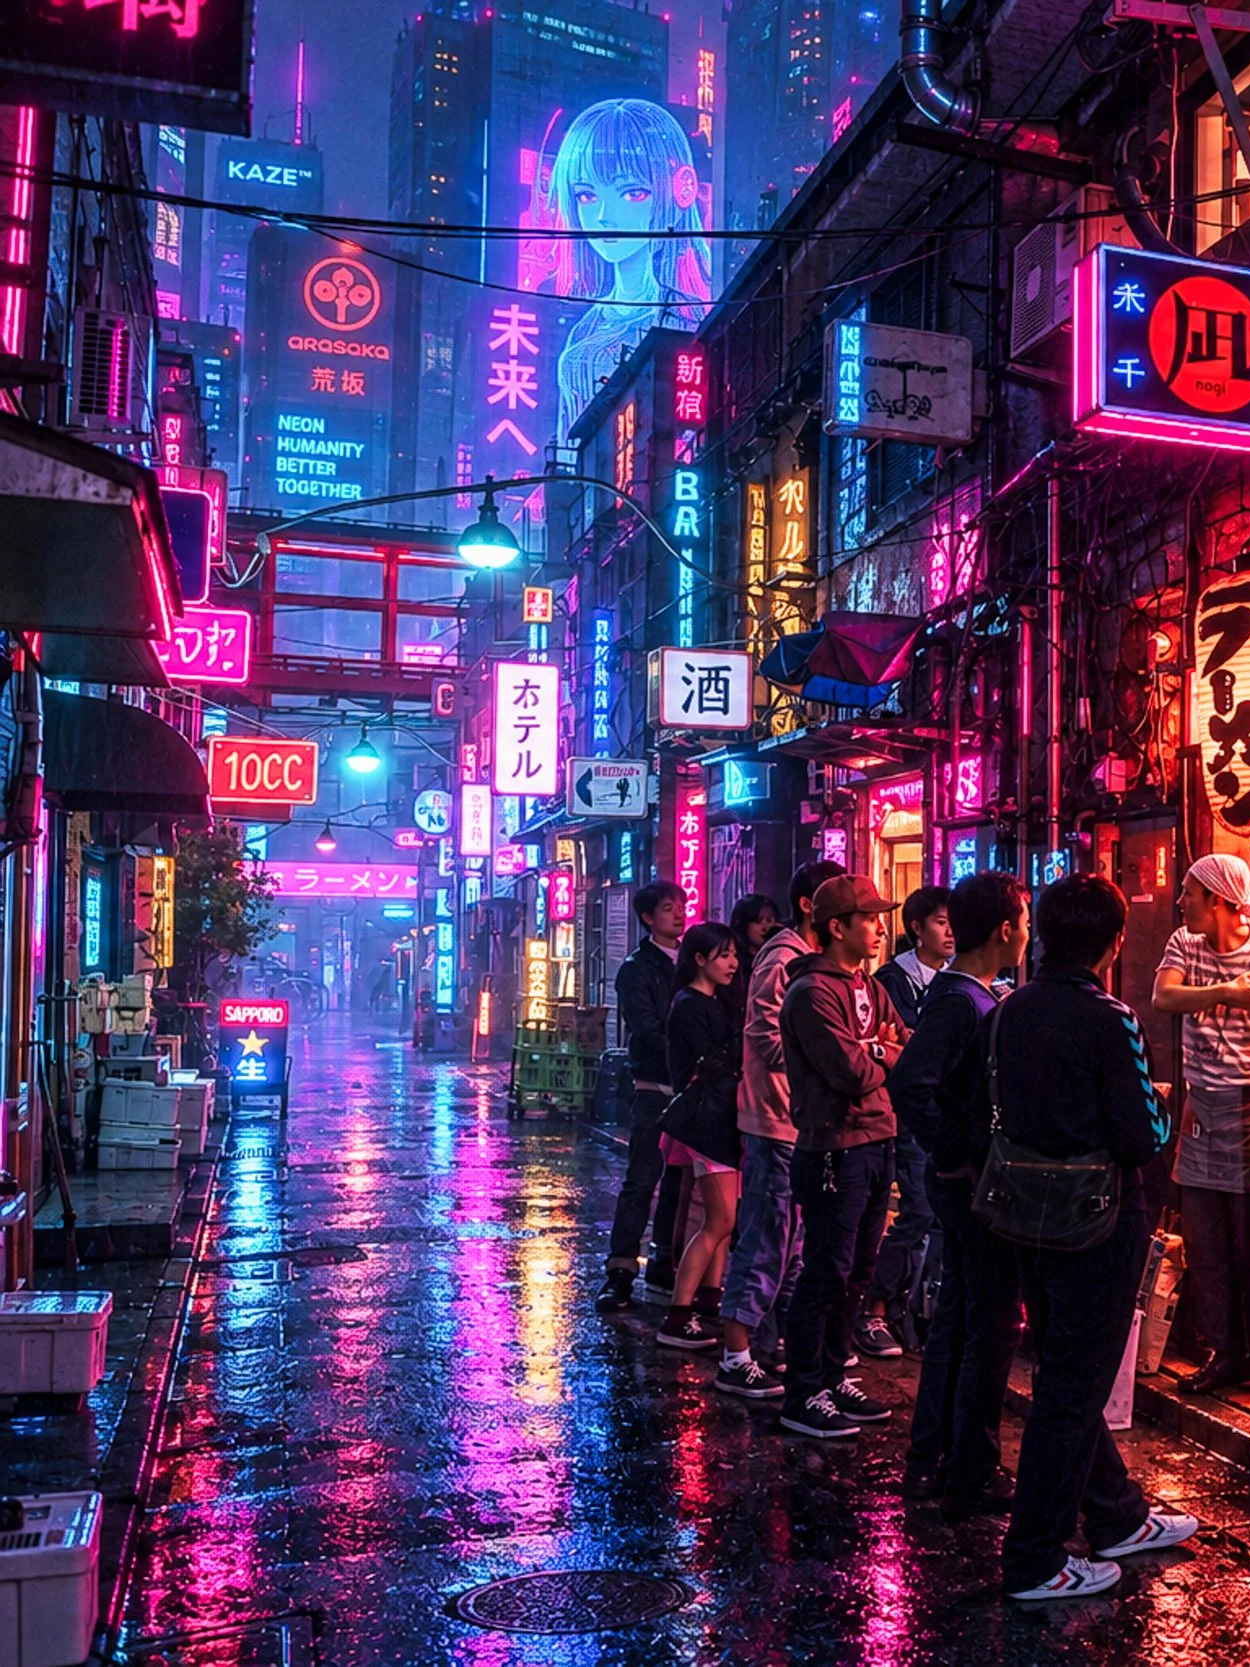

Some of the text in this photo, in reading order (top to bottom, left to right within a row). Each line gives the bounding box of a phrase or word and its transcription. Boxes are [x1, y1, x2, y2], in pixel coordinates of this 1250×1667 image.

[485, 304, 540, 457] 未来へ
[278, 415, 325, 434] NEON
[277, 436, 365, 459] HUMANITY
[276, 457, 336, 476] BETTER
[275, 478, 363, 500] TOGETHER
[681, 663, 733, 717] 酒
[512, 679, 542, 779] ホテル
[224, 751, 302, 791] 10CC
[294, 868, 399, 891] ラーメン
[224, 1005, 284, 1023] SAPPORO
[235, 1057, 267, 1080] 生
